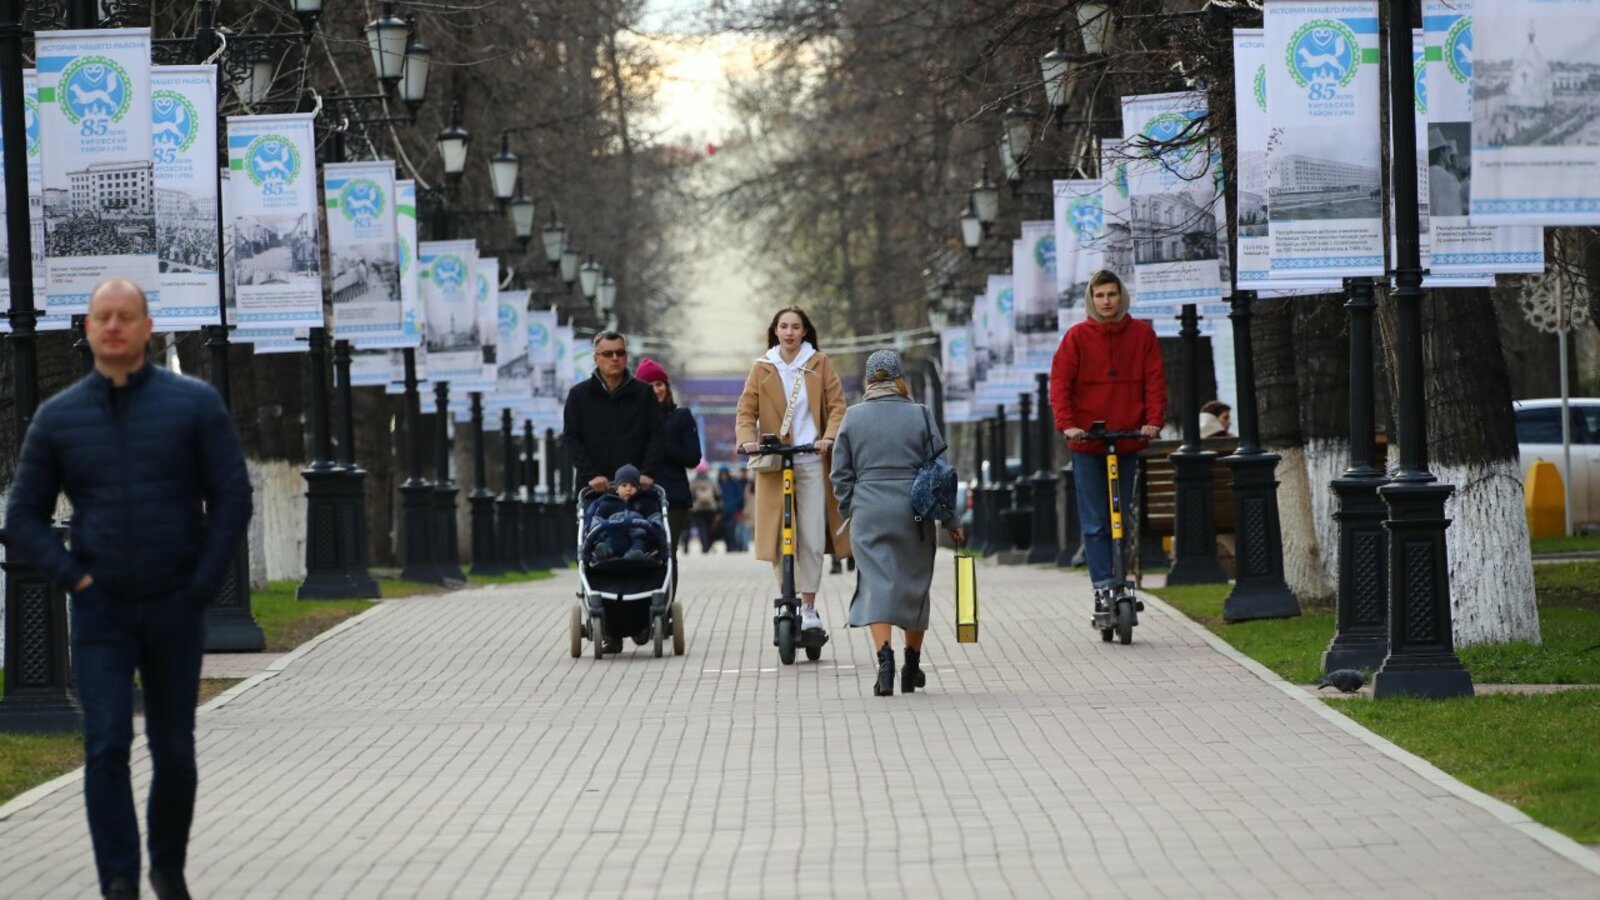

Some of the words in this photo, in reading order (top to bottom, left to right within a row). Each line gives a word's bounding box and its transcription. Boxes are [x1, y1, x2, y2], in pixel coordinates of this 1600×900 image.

[1269, 6, 1306, 14] ИСТОРИЯ
[1342, 5, 1374, 13] РАЙОНА
[40, 44, 77, 52] ИСТОРИЯ
[113, 41, 145, 50] РАЙОНА
[1308, 83, 1337, 101] 85
[1308, 101, 1355, 109] КИРОВСКИЙ
[81, 118, 109, 137] 85
[81, 137, 127, 145] КИРОВСКИЙ
[153, 147, 177, 164] 85
[262, 182, 284, 196] 85
